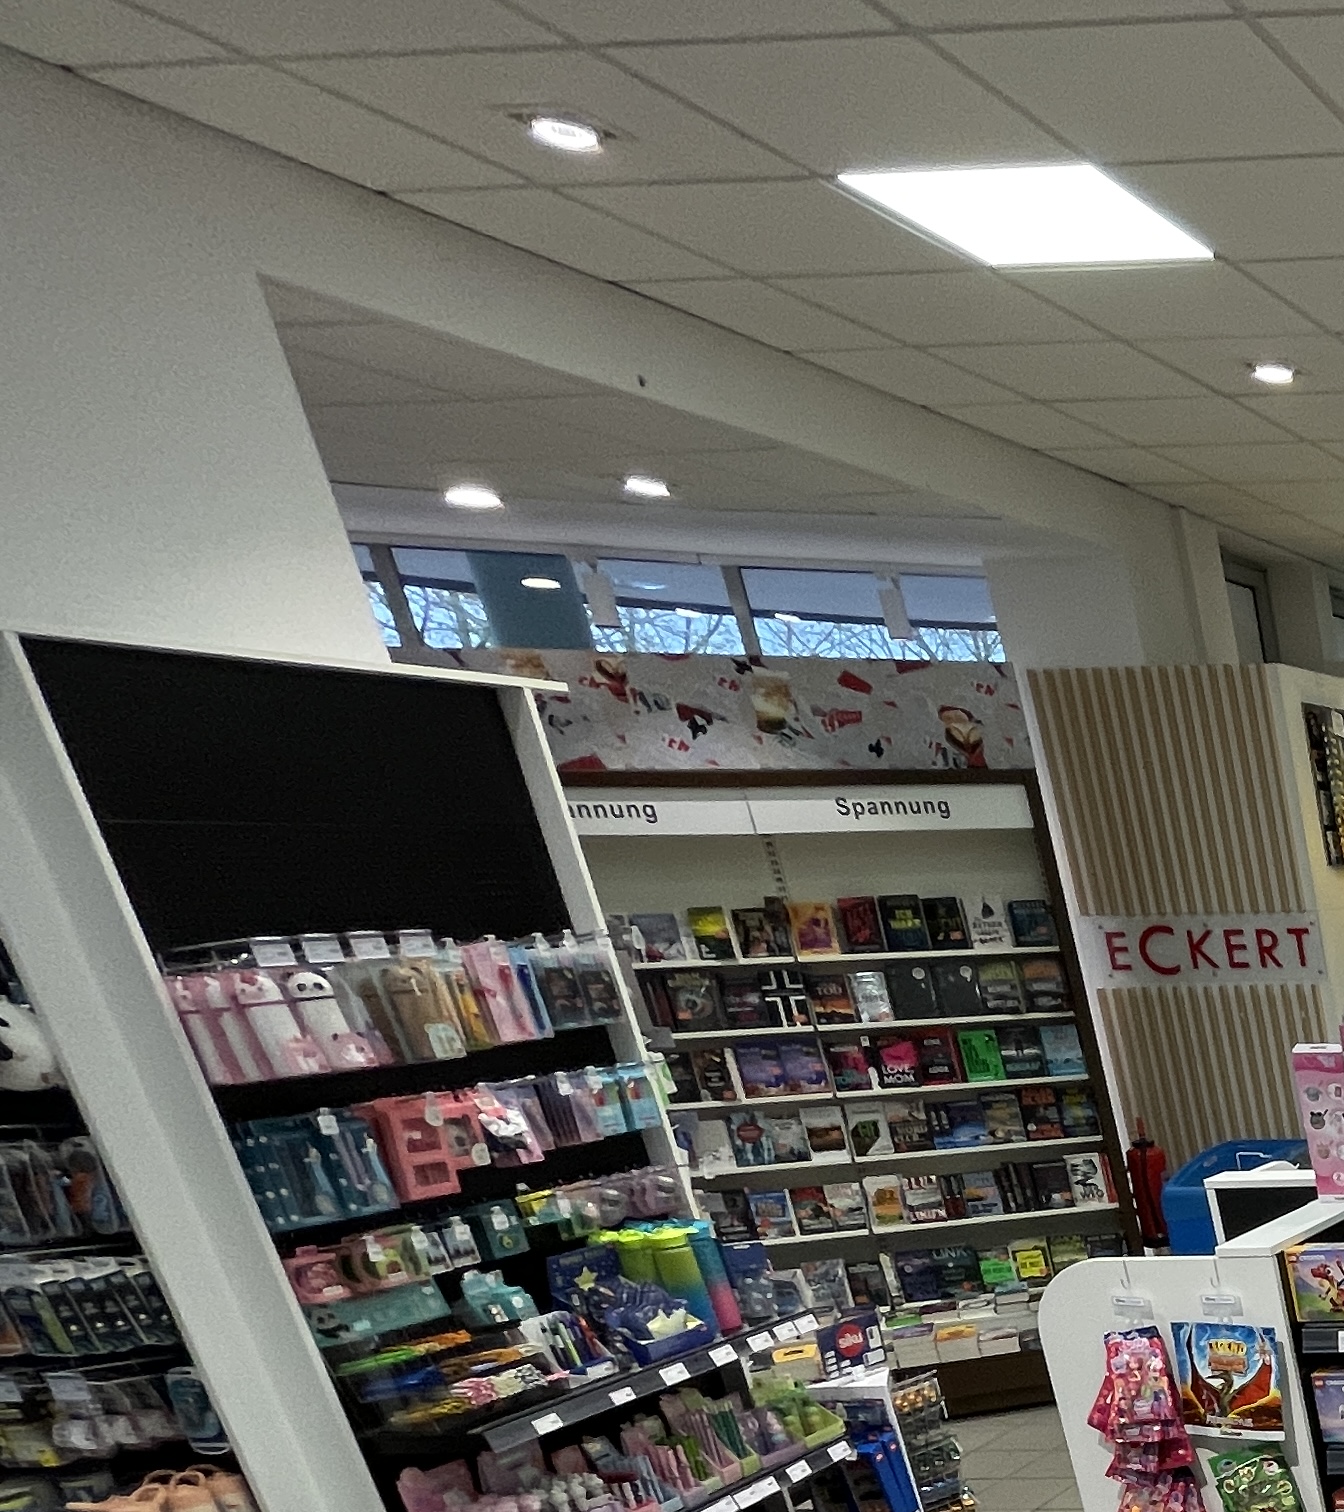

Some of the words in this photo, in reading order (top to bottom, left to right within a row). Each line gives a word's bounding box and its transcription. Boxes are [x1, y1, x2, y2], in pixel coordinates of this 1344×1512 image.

[835, 795, 951, 820] Spannung
[1104, 924, 1312, 977] ECKERT
[838, 1332, 864, 1349] siku
